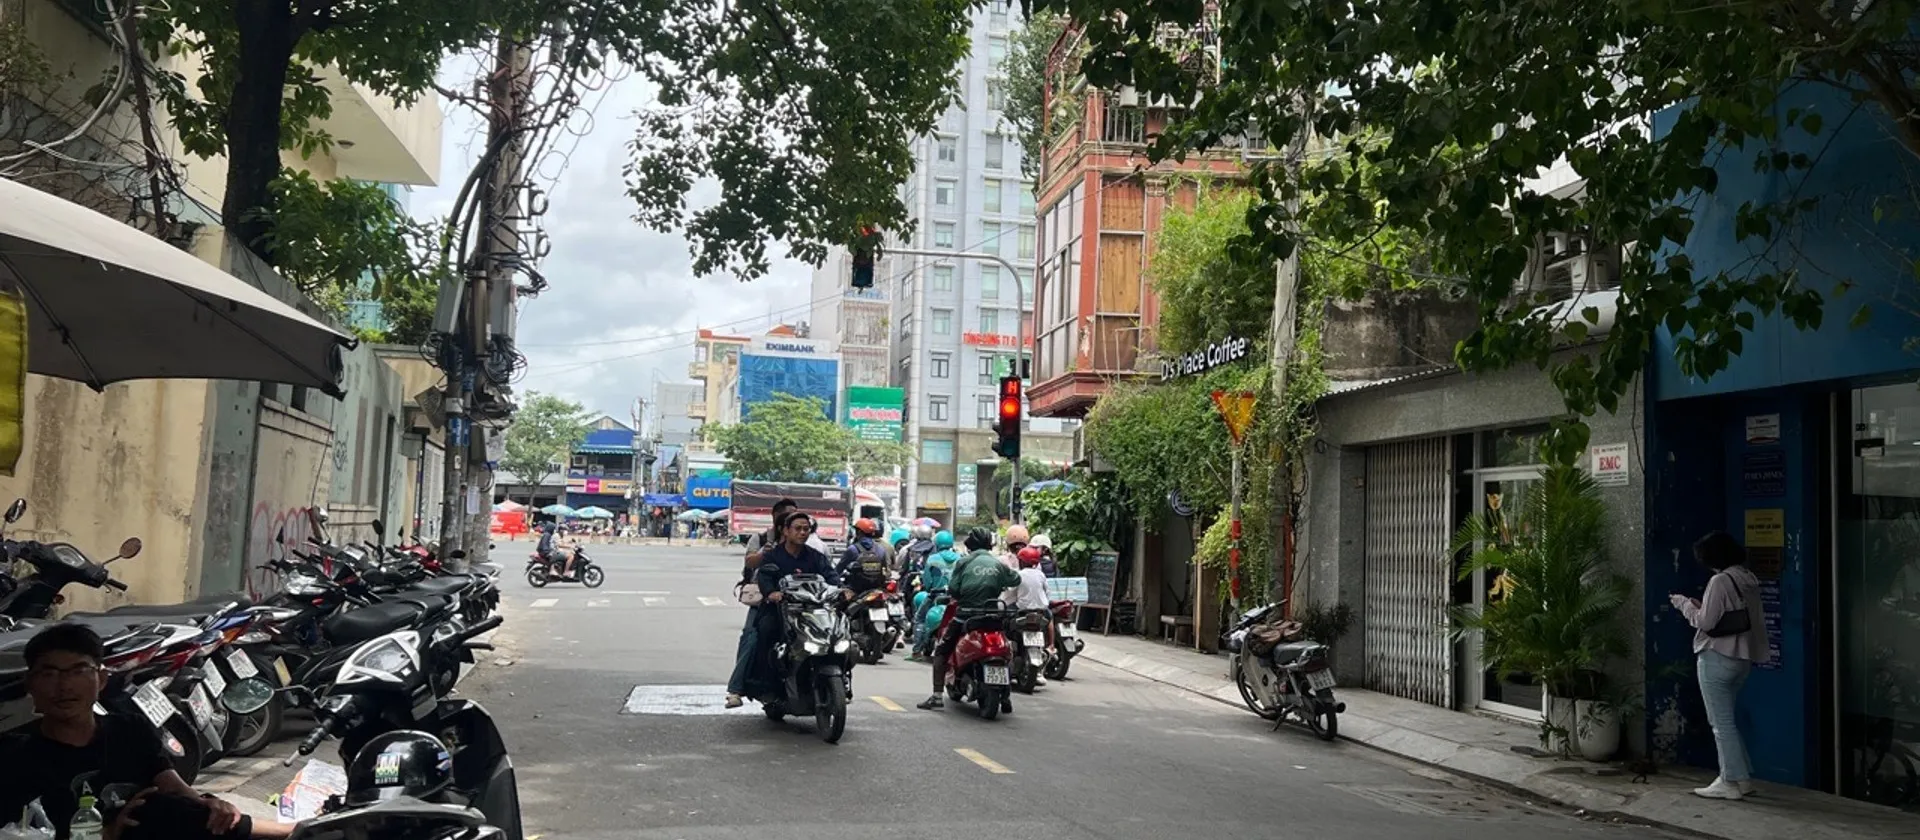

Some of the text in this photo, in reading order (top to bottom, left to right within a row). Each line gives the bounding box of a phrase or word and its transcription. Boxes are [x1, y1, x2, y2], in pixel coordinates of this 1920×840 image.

[766, 342, 815, 353] EXIMBANK
[1207, 335, 1245, 367] Coffee
[1599, 455, 1621, 471] EMC
